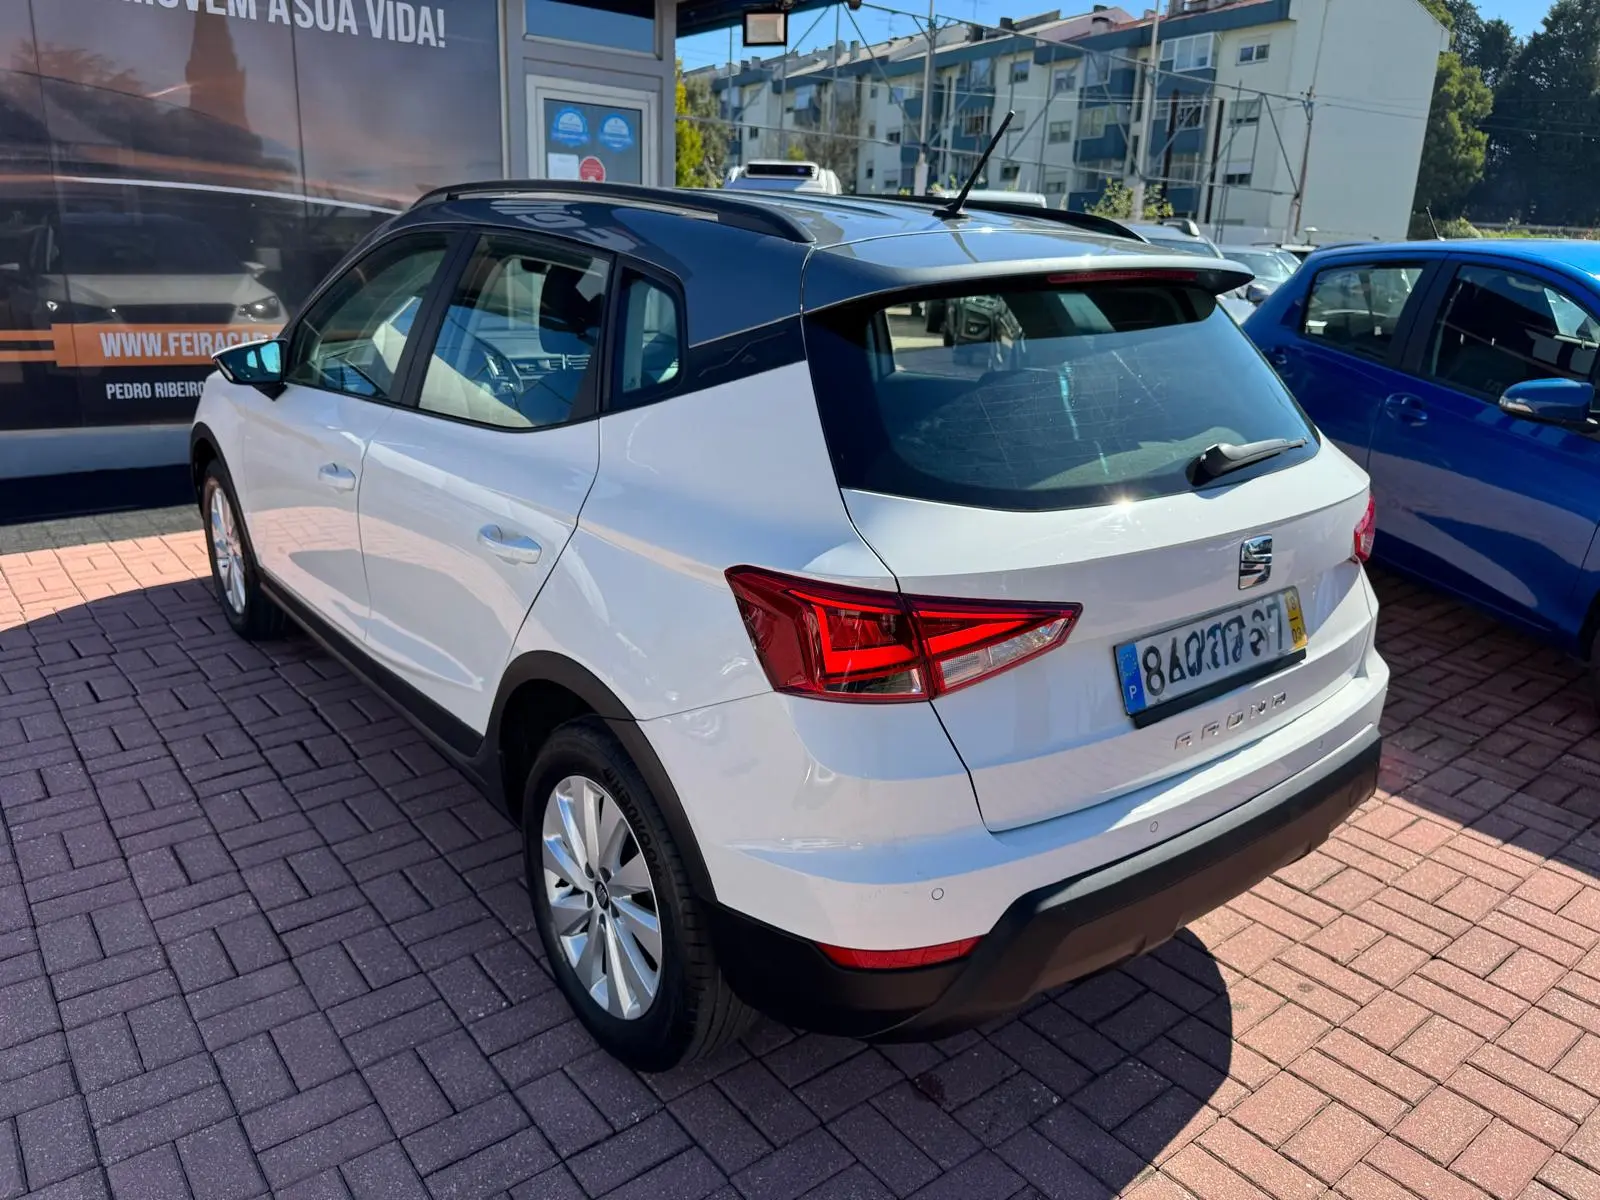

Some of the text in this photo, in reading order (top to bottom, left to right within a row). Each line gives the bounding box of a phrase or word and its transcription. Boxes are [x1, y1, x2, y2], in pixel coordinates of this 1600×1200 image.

[364, 0, 446, 48] VIDA!
[105, 381, 206, 400] PEDRO RIBEIRO
[1128, 685, 1138, 700] P
